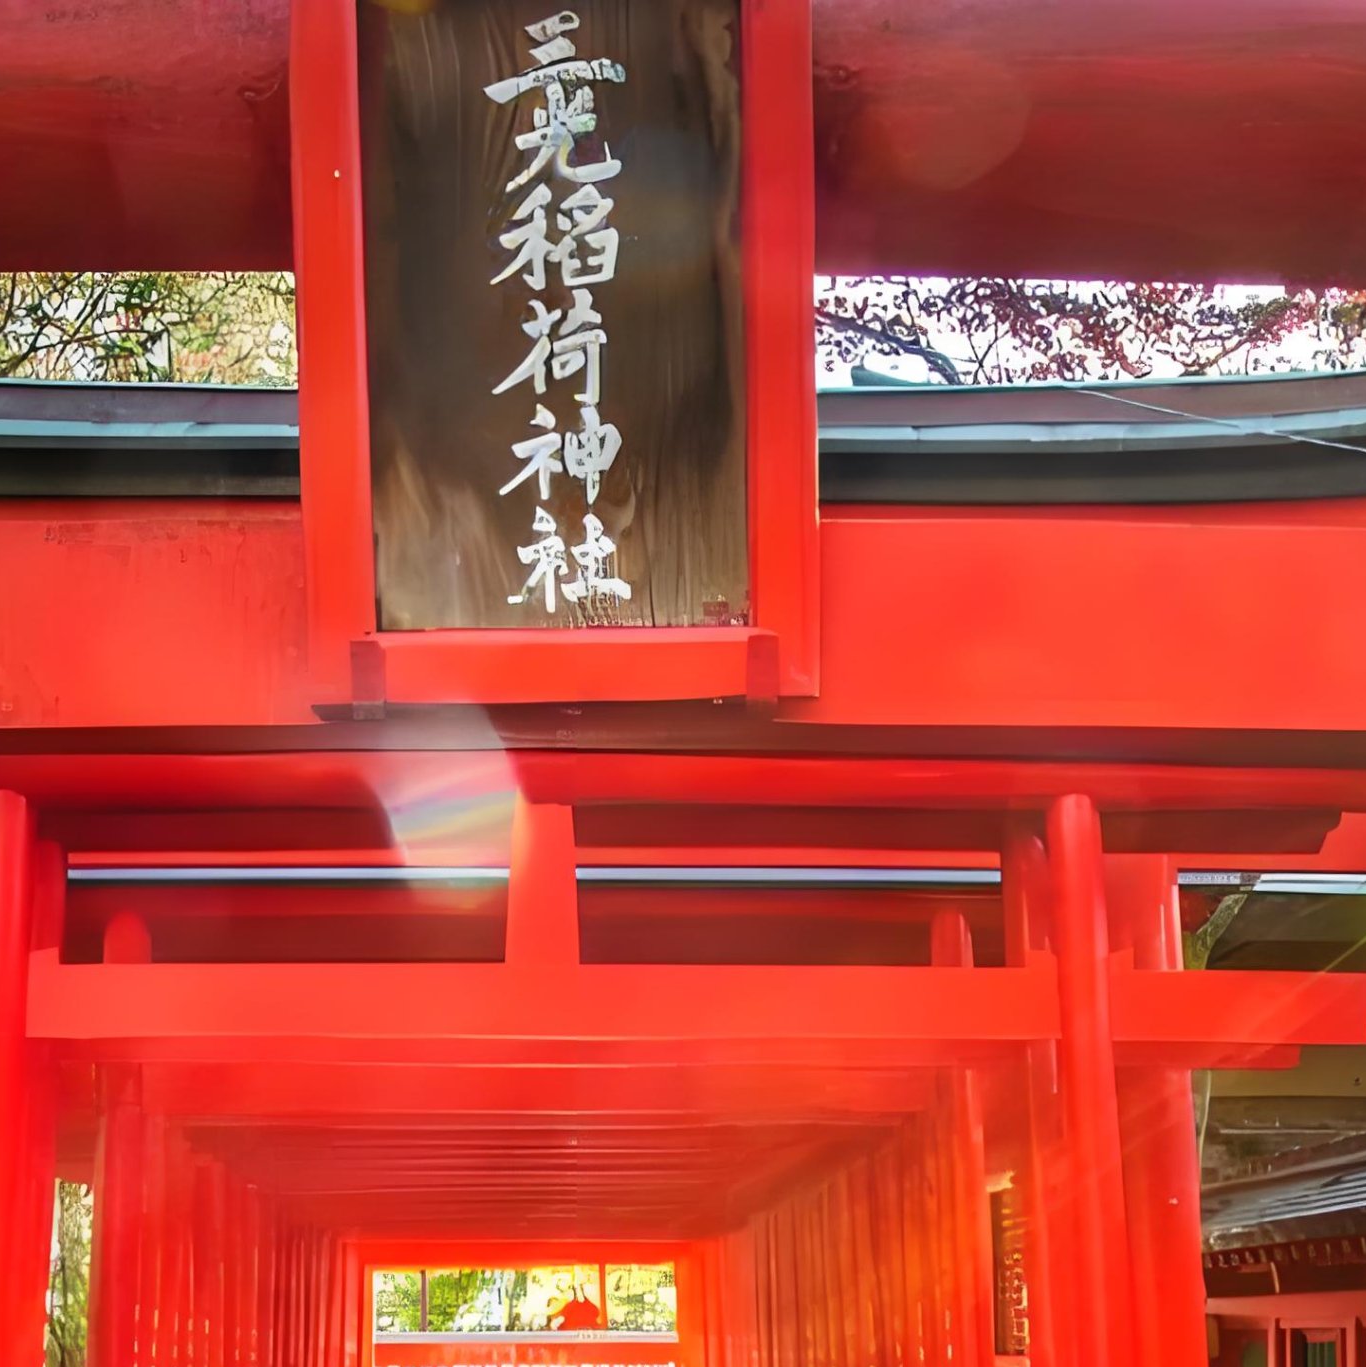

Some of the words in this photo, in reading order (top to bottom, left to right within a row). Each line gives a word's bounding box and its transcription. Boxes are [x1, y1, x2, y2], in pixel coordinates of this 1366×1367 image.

[483, 10, 631, 613] 三光稲荷神社
